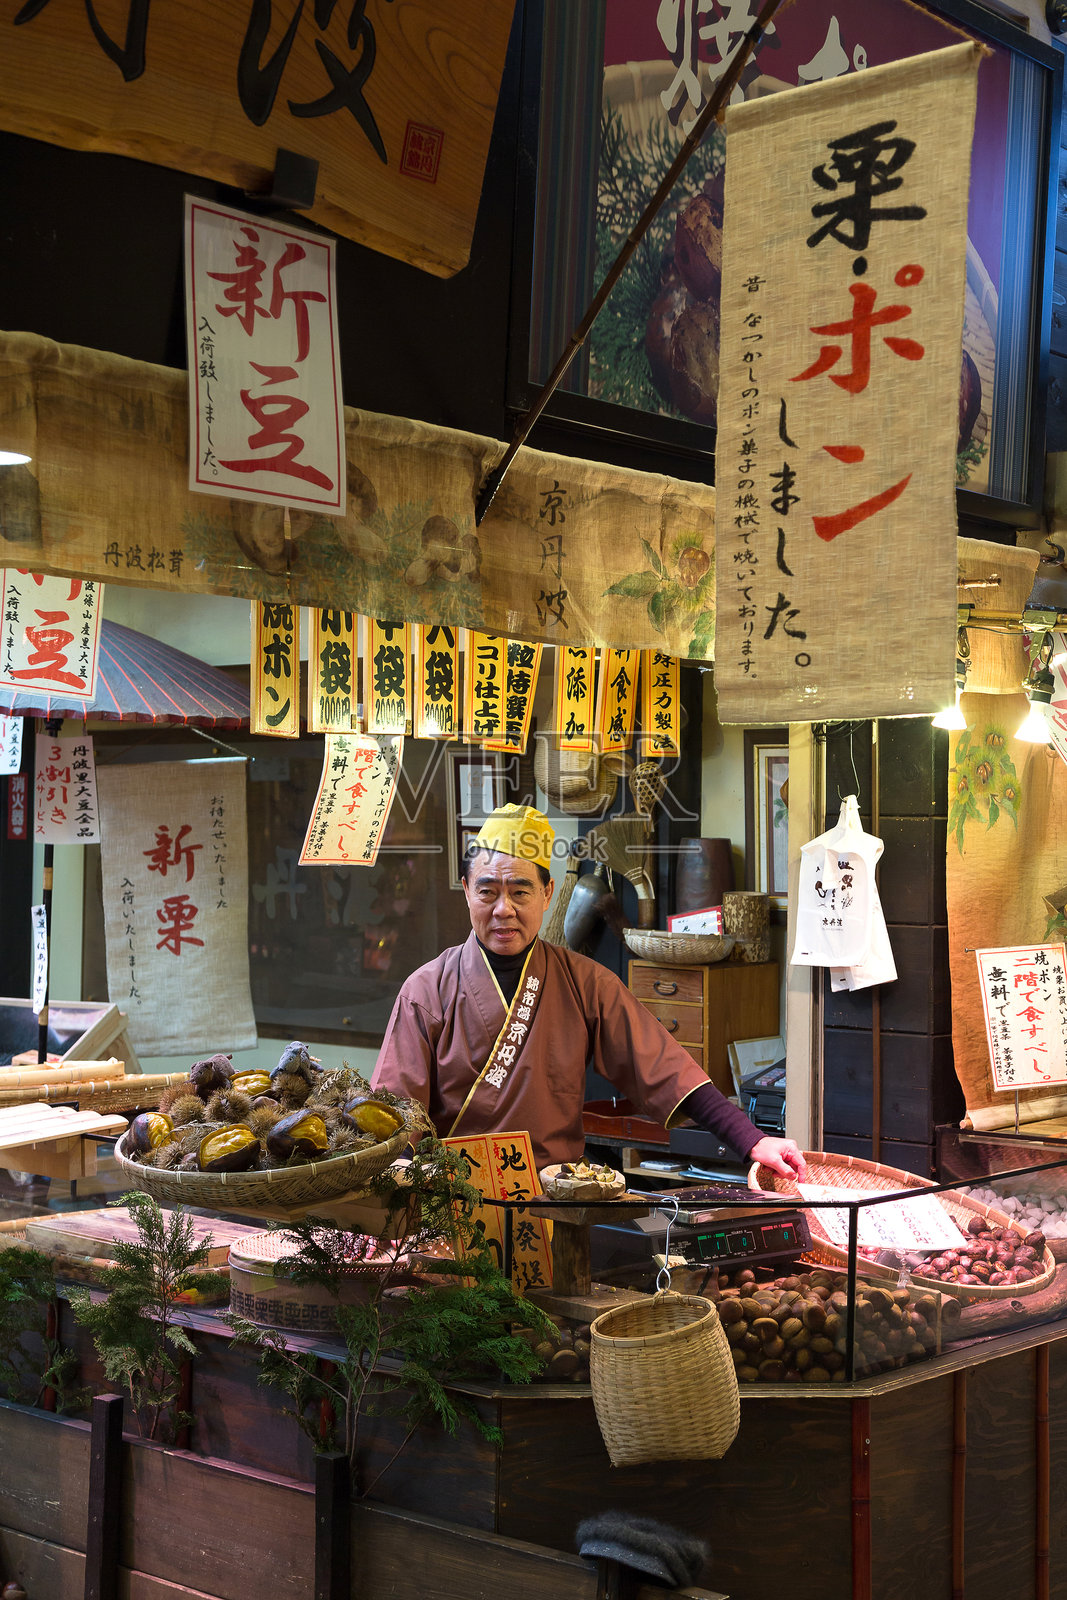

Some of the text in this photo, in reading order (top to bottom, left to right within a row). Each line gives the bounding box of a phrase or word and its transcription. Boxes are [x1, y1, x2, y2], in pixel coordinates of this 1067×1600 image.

[198, 315, 219, 477] 入荷致しました。
[206, 226, 335, 492] 新豆
[536, 480, 570, 631] 京丹波
[763, 397, 812, 668] しました。
[4, 584, 22, 681] 入荷致しました。
[473, 633, 501, 738] コリ仕上げ
[8, 716, 21, 768] 大豆全品
[45, 745, 72, 825] 3割引き
[35, 769, 46, 835] 大サービス
[120, 877, 142, 1006] 入荷いたしました。
[142, 824, 205, 957] 新栗
[987, 966, 1011, 1018] 無料で
[1012, 957, 1053, 1081] 二階で食すべし。
[1034, 949, 1053, 1002] 焼ポン
